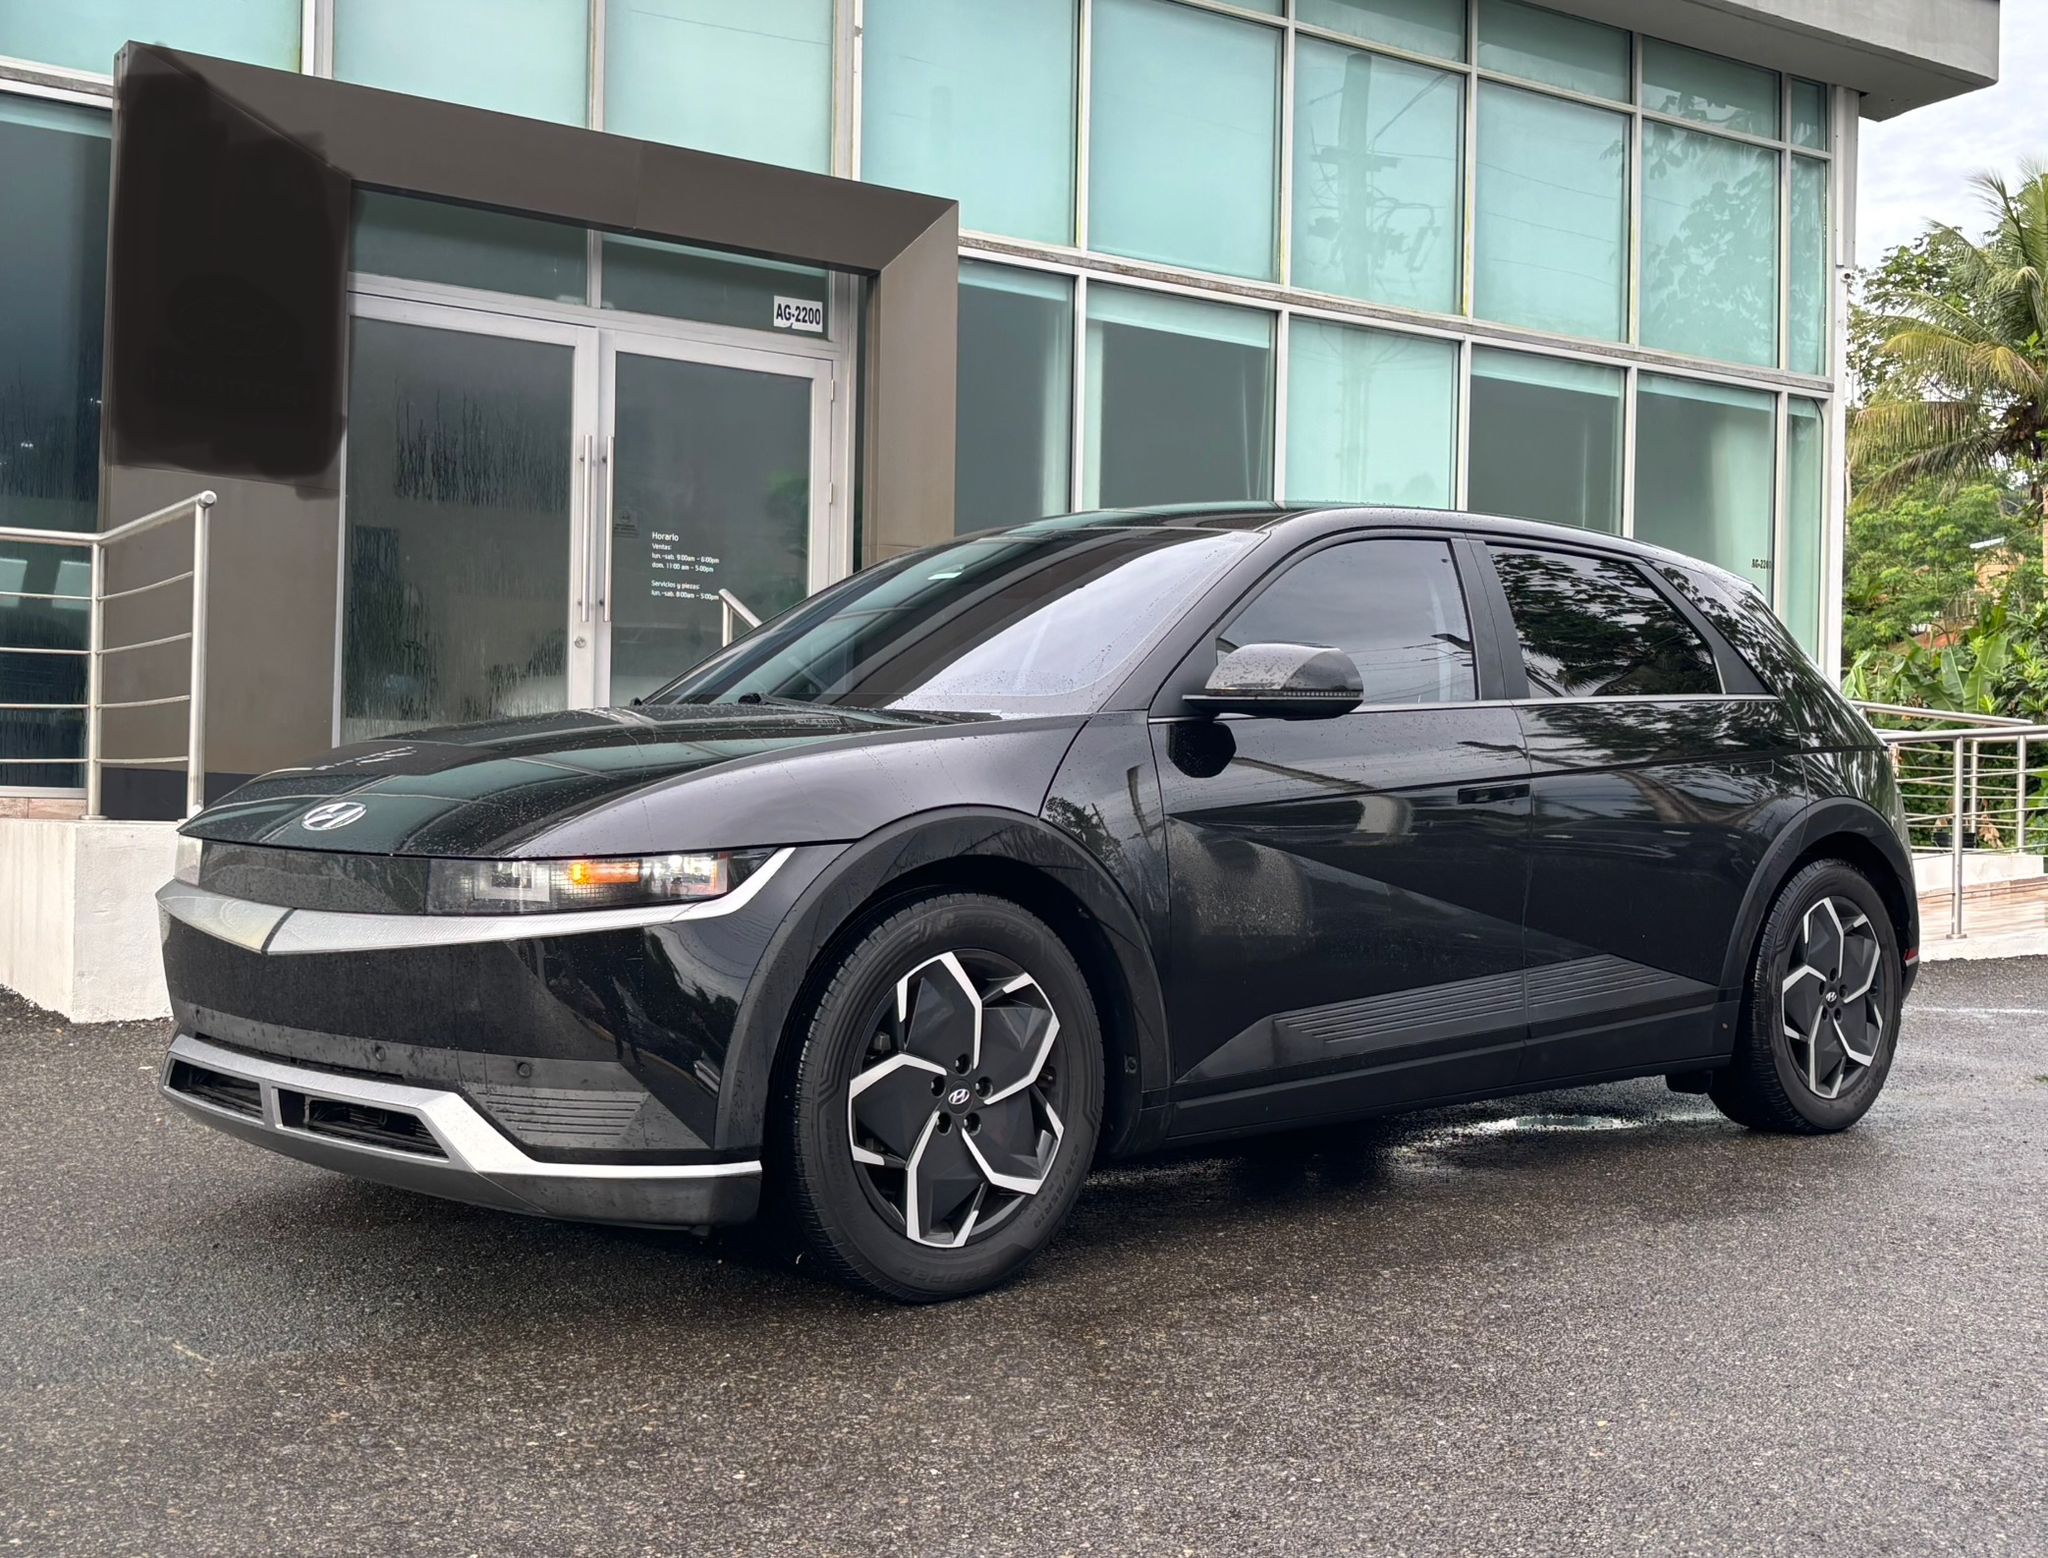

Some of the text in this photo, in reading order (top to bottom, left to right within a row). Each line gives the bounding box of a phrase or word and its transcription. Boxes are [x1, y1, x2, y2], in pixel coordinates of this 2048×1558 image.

[776, 303, 821, 325] AG-2200
[652, 531, 679, 542] Horario
[651, 579, 676, 588] Servicios
